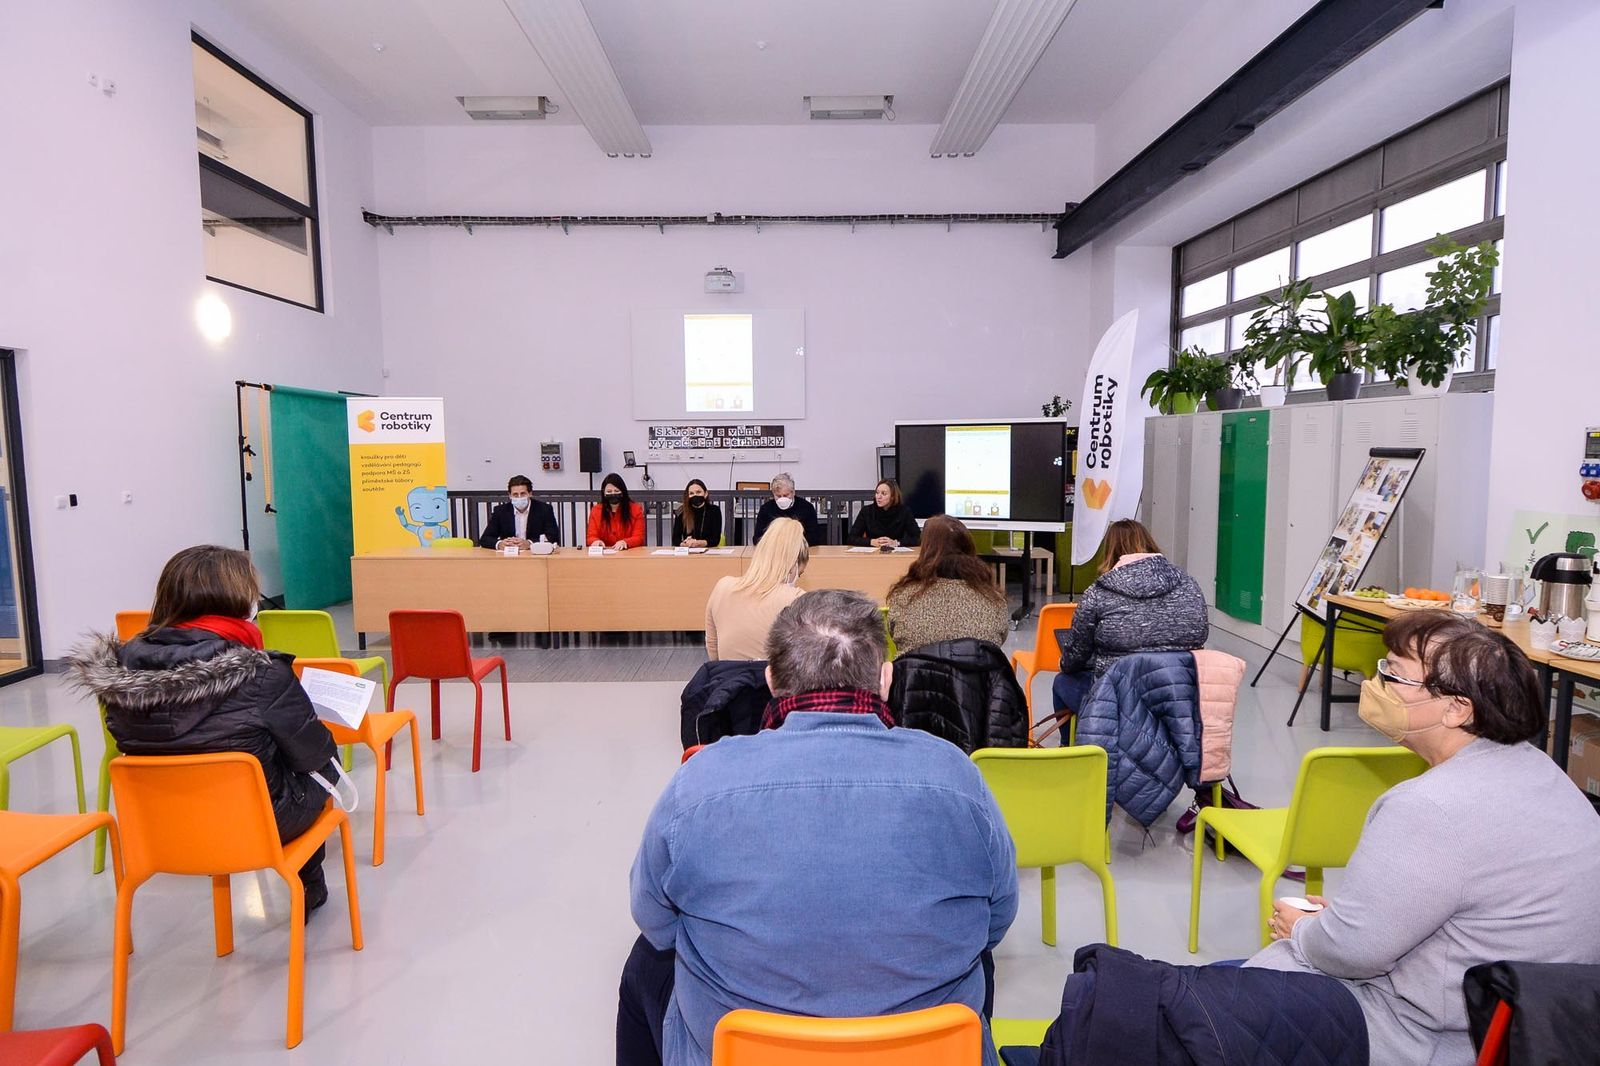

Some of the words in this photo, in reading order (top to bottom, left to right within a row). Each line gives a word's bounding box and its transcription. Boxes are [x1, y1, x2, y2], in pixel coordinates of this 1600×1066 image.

[380, 412, 433, 421] Centrum
[1086, 375, 1104, 469] Centrum
[381, 420, 431, 432] robotiky
[1099, 377, 1118, 469] robotiky
[656, 427, 712, 437] Skvosty
[718, 428, 724, 436] s
